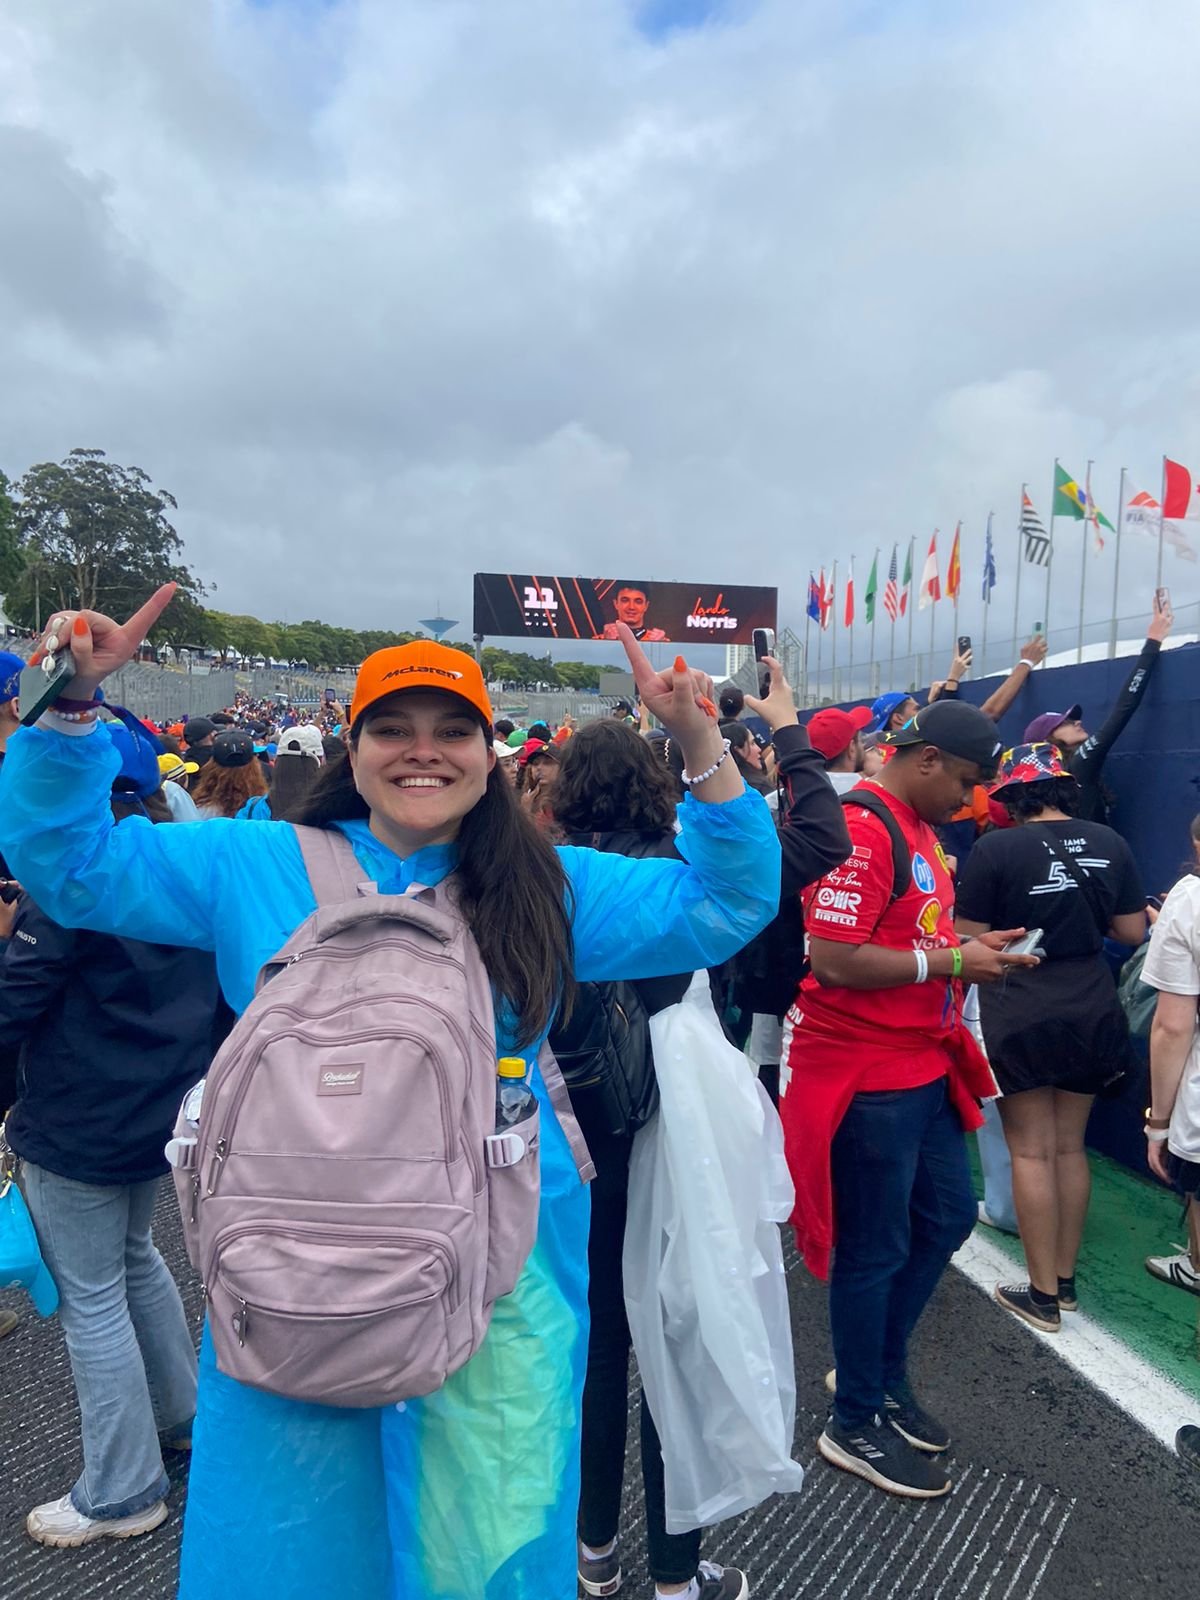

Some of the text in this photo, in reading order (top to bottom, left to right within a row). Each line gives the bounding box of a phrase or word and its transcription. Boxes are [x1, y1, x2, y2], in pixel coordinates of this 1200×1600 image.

[524, 586, 558, 609] 11
[686, 614, 738, 629] Norris
[381, 665, 458, 681] McLaren
[827, 867, 862, 888] Ray-Ban
[815, 908, 858, 927] PIRELLI
